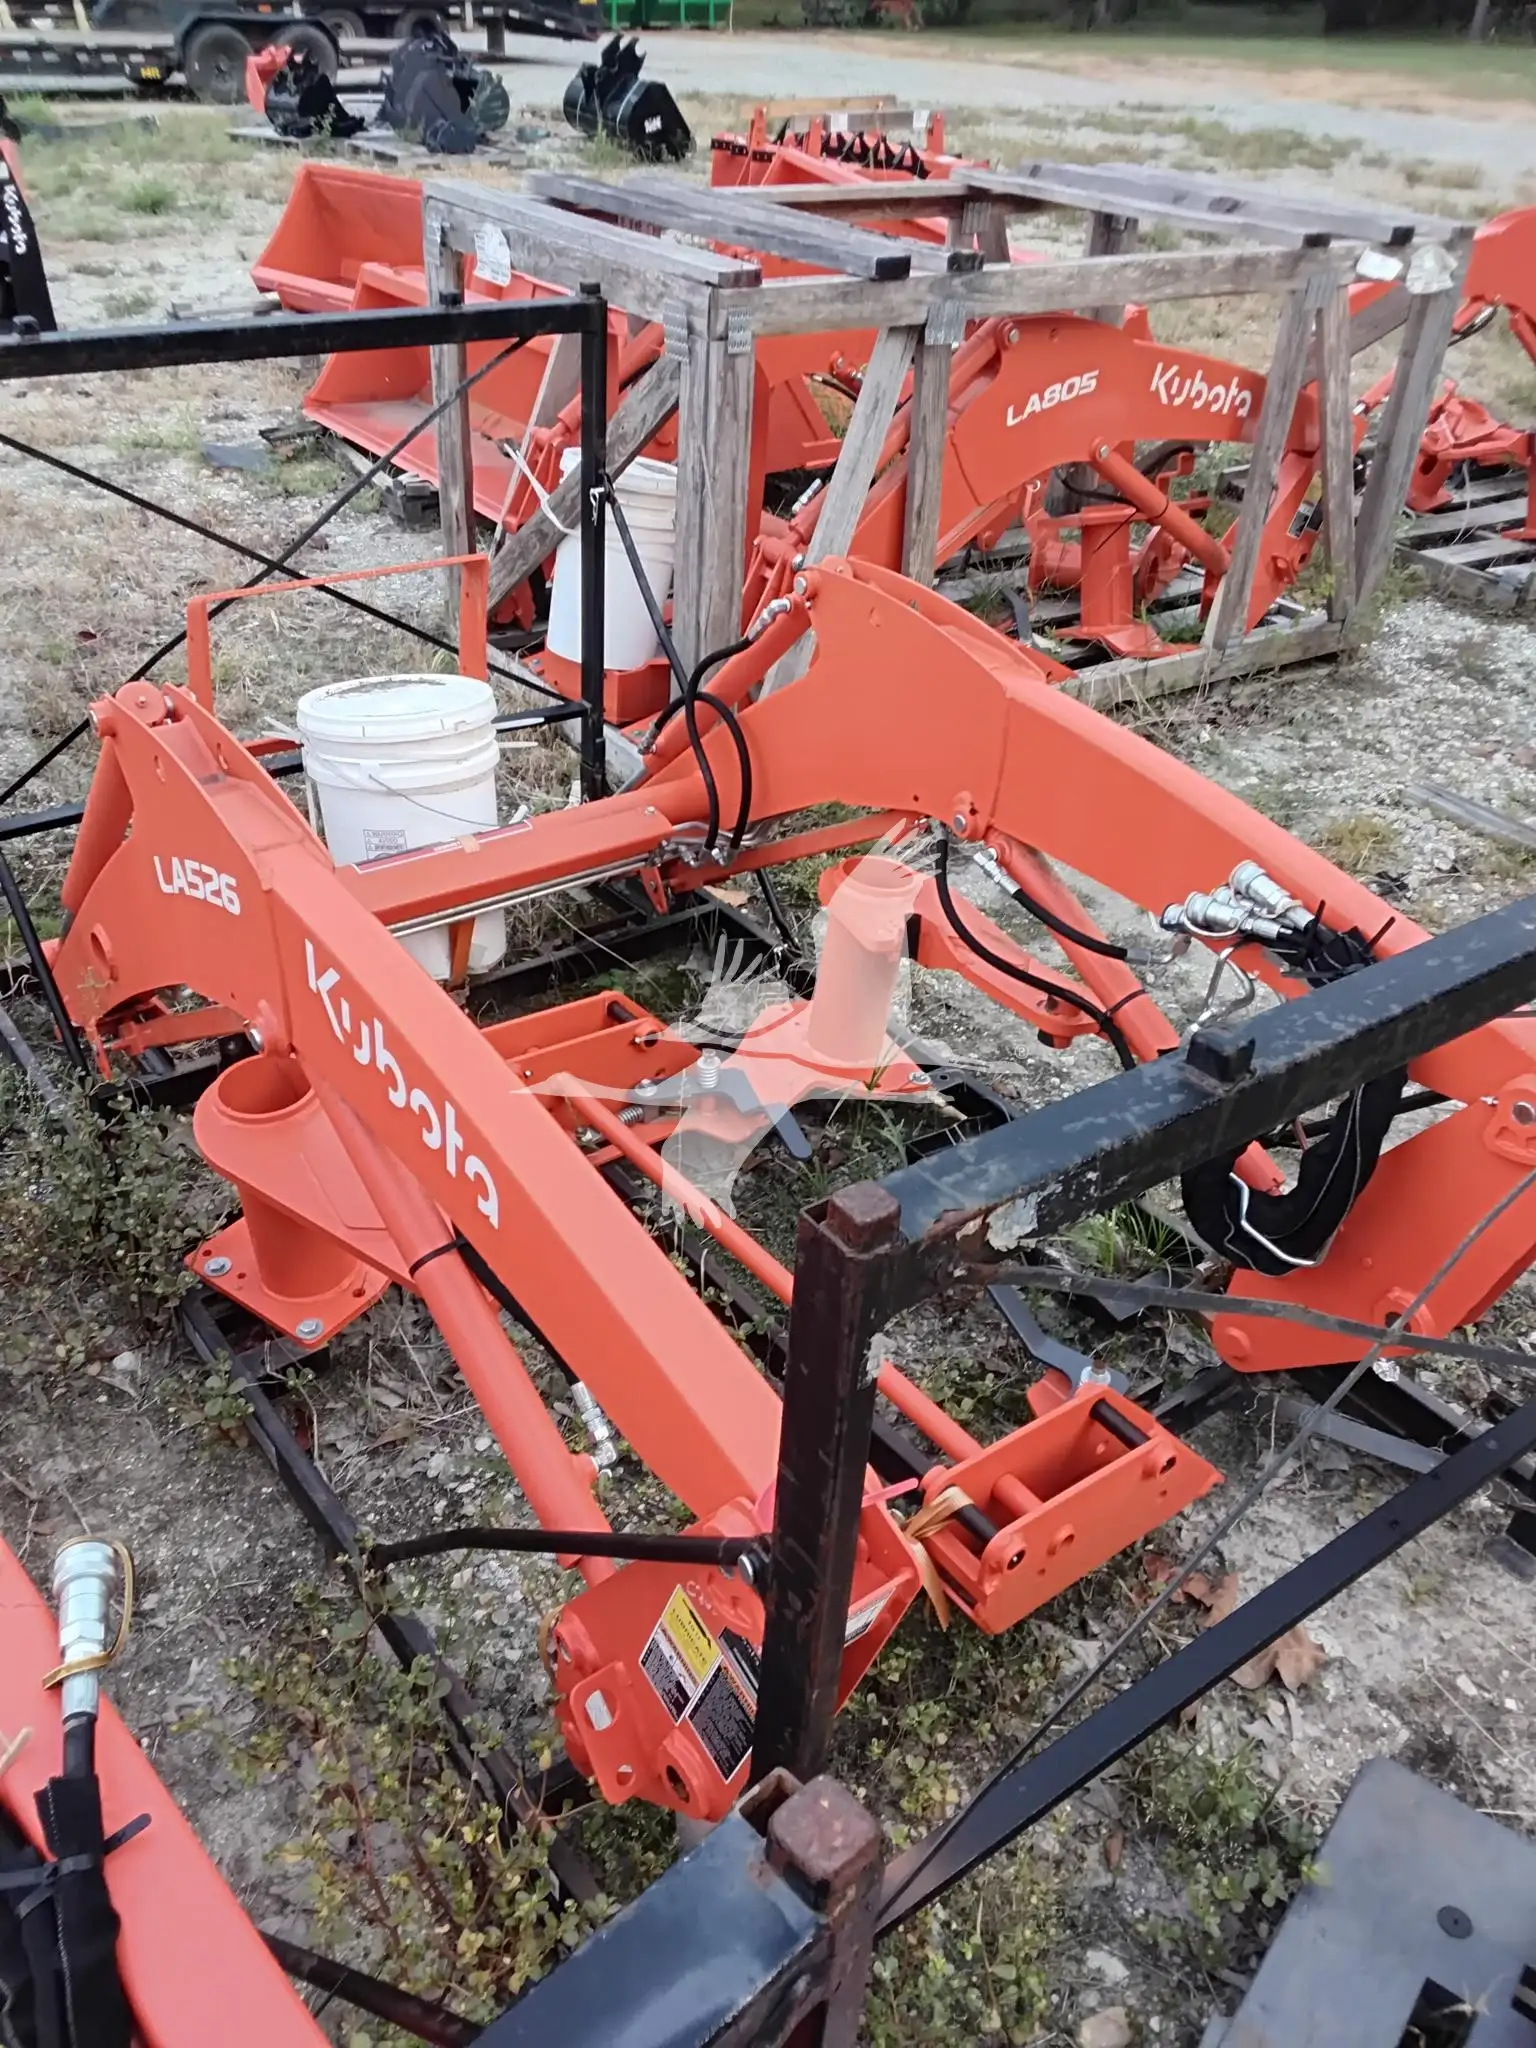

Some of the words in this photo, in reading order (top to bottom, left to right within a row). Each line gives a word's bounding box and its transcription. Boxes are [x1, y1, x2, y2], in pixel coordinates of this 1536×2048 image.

[1006, 369, 1099, 427] LA805
[1150, 361, 1252, 418] Kubota
[153, 855, 241, 916] LA526
[304, 938, 499, 1230] Kubota
